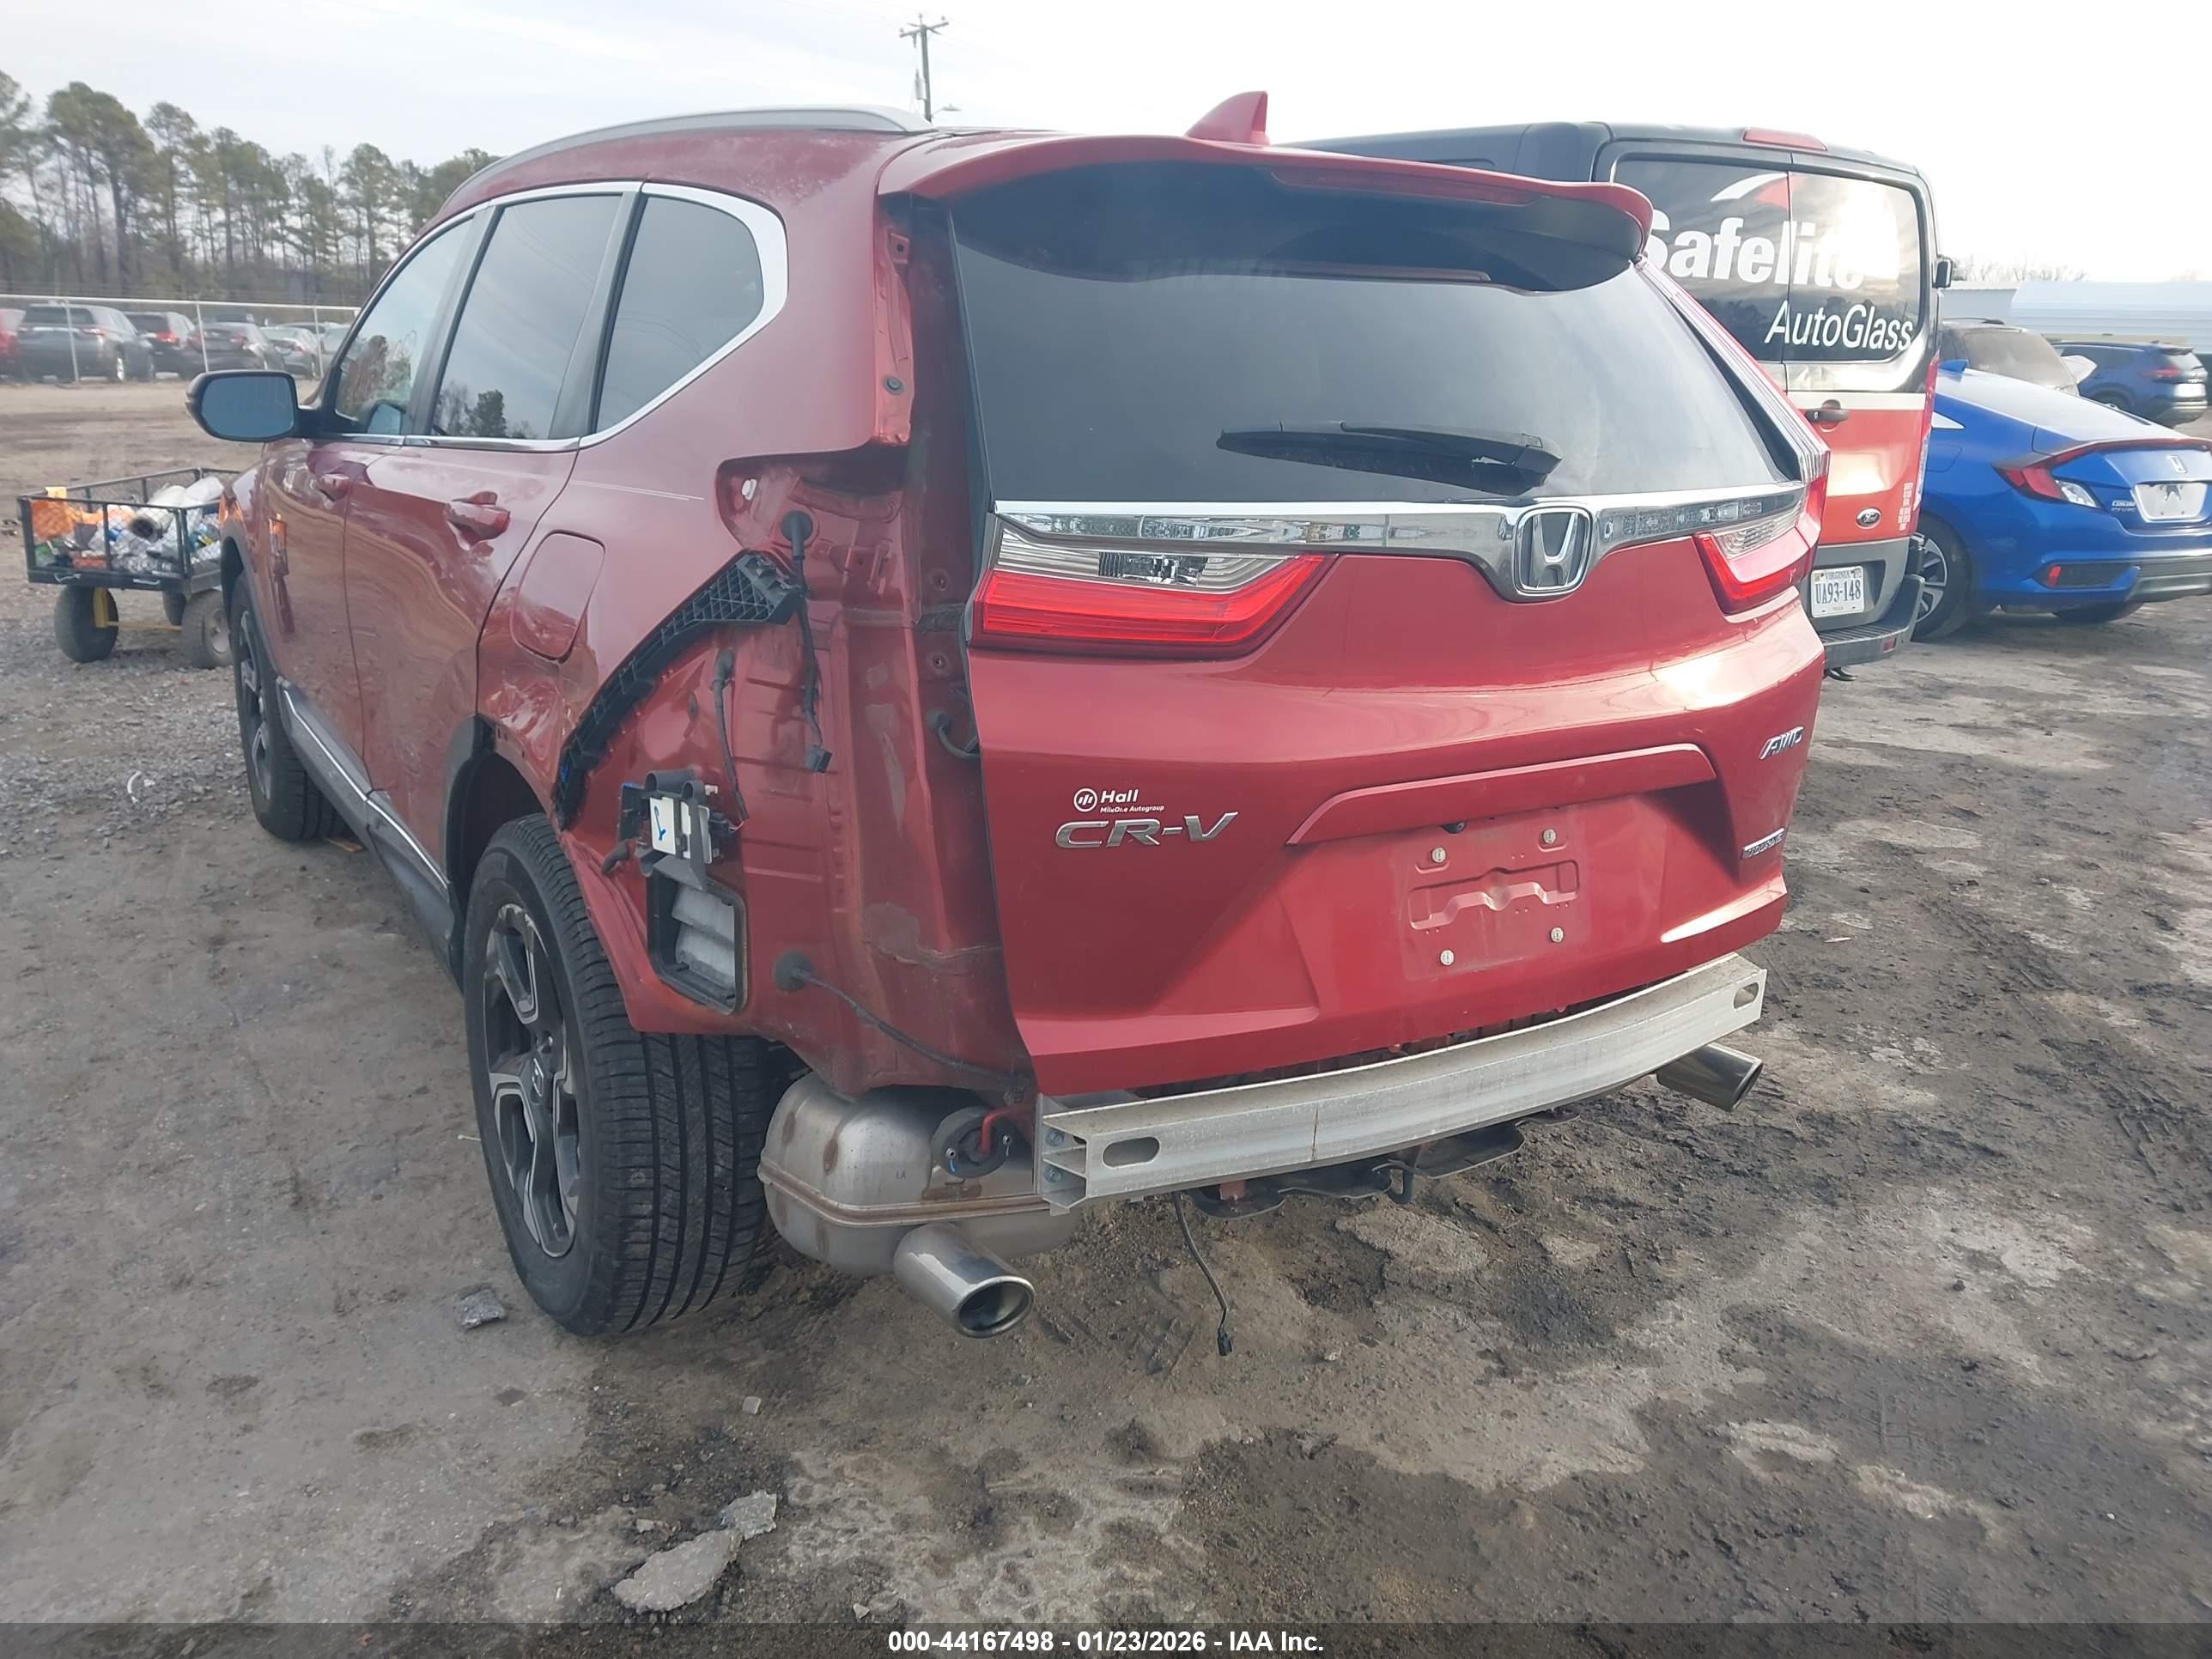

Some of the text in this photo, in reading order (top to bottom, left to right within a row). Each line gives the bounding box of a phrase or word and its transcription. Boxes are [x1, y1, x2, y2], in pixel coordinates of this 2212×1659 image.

[1764, 299, 1914, 351] AutoGlass
[1826, 569, 1850, 580] VIRGINIA
[1814, 579, 1862, 605] UA93-148
[1100, 788, 1139, 804] Hall
[1129, 805, 1165, 813] Autogroup
[1054, 811, 1239, 849] CR-V
